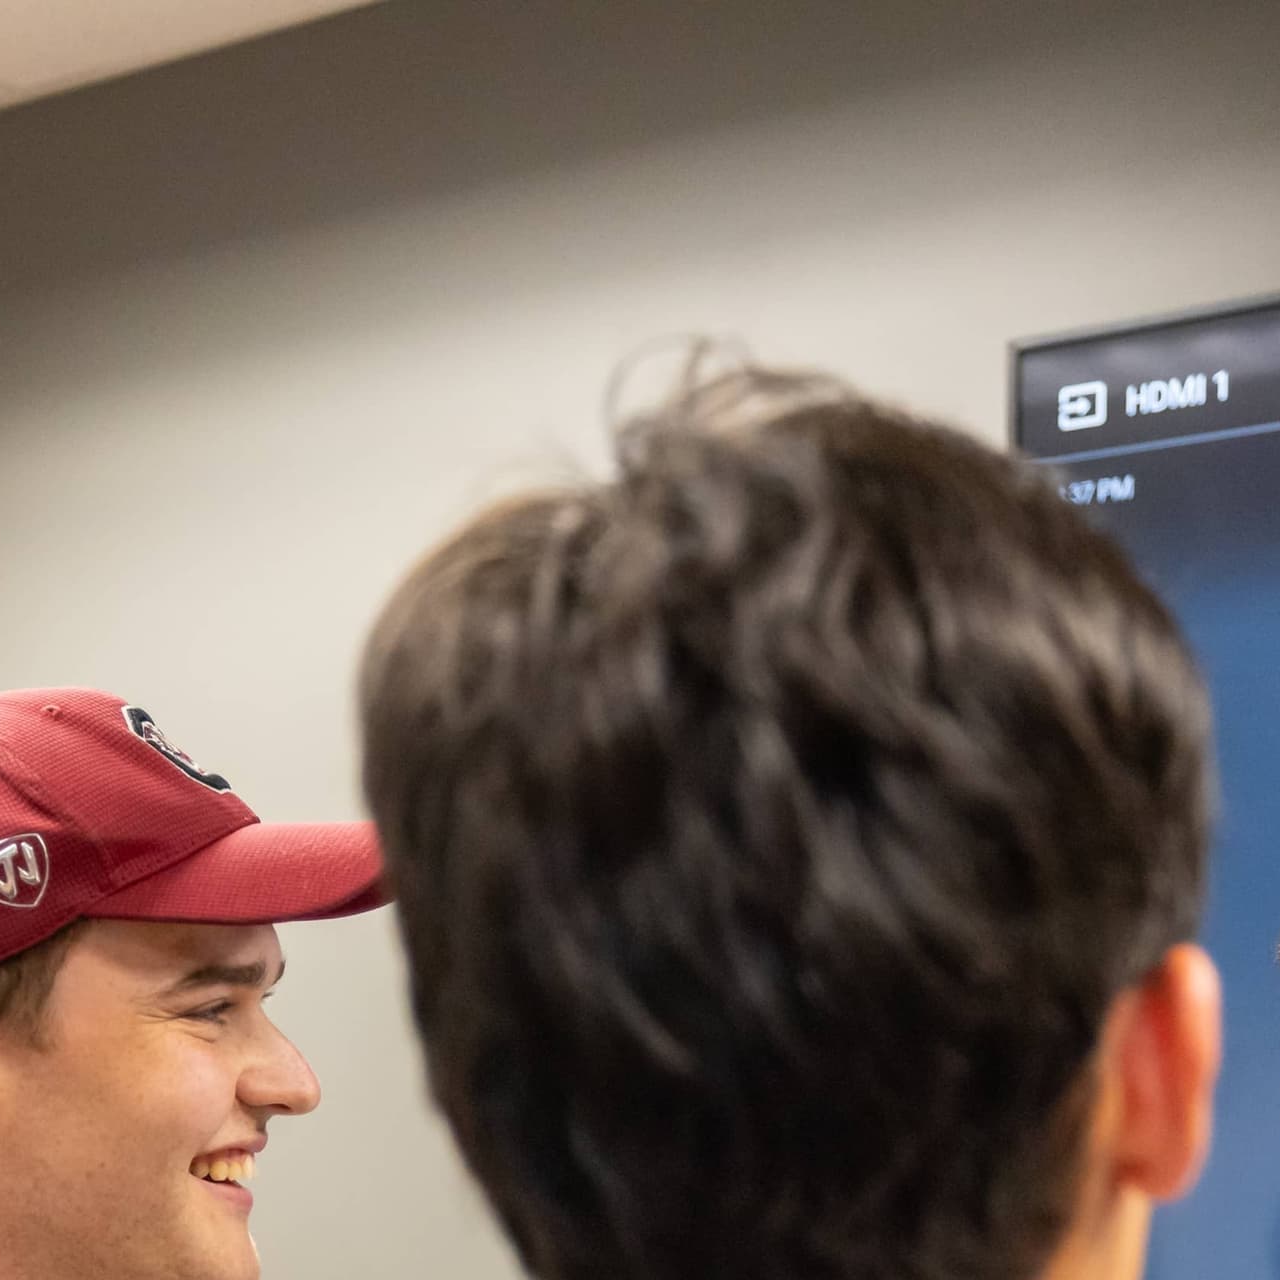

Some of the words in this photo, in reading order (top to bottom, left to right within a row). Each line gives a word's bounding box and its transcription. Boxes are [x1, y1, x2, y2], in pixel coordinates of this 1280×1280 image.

[1125, 373, 1207, 416] HDMI
[1212, 369, 1229, 402] 1
[1097, 474, 1135, 504] PM
